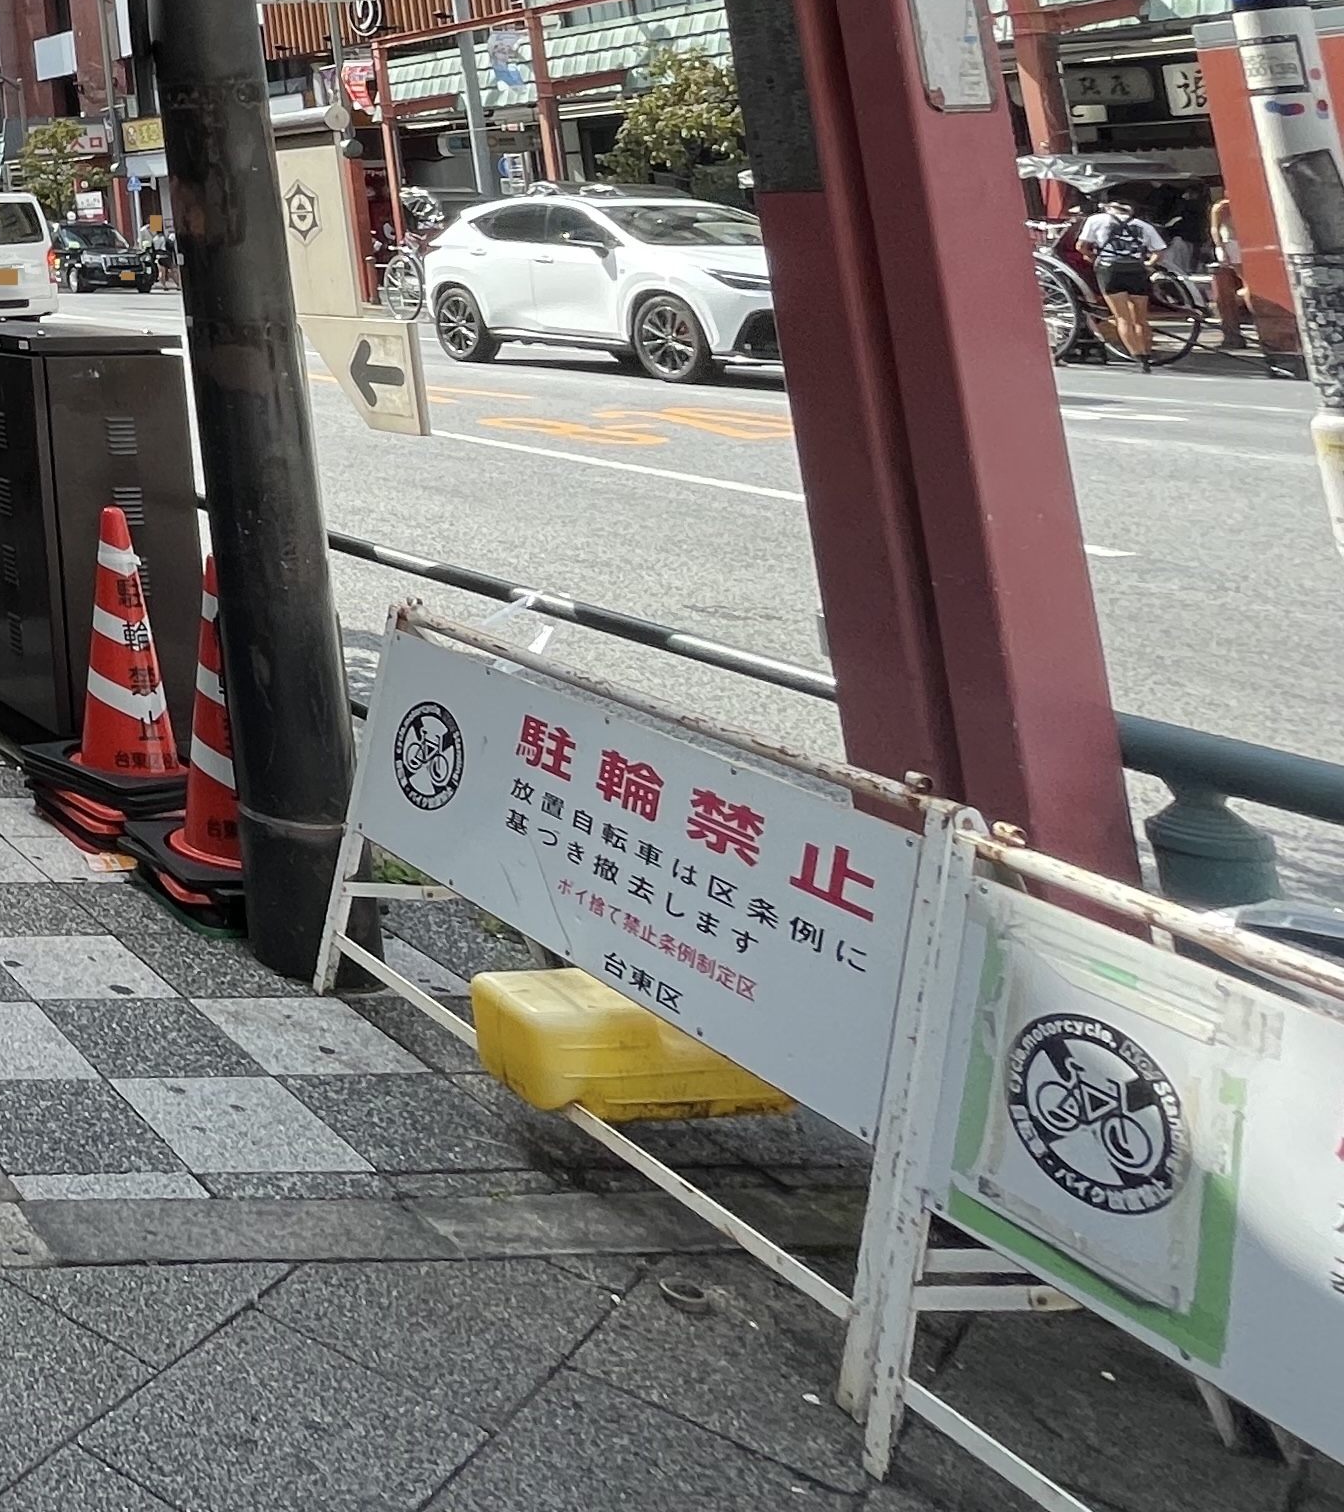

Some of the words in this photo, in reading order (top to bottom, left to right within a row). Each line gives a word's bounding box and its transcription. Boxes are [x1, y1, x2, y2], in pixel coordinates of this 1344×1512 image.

[116, 577, 165, 742] 駐輪禁止
[504, 808, 760, 955] 基づき撤去します
[509, 776, 869, 974] 放置自転車は区条例に
[516, 713, 876, 923] 駐輪禁止
[556, 877, 759, 1004] ポイ捨て禁止条例制定区
[603, 951, 685, 1017] 台東区
